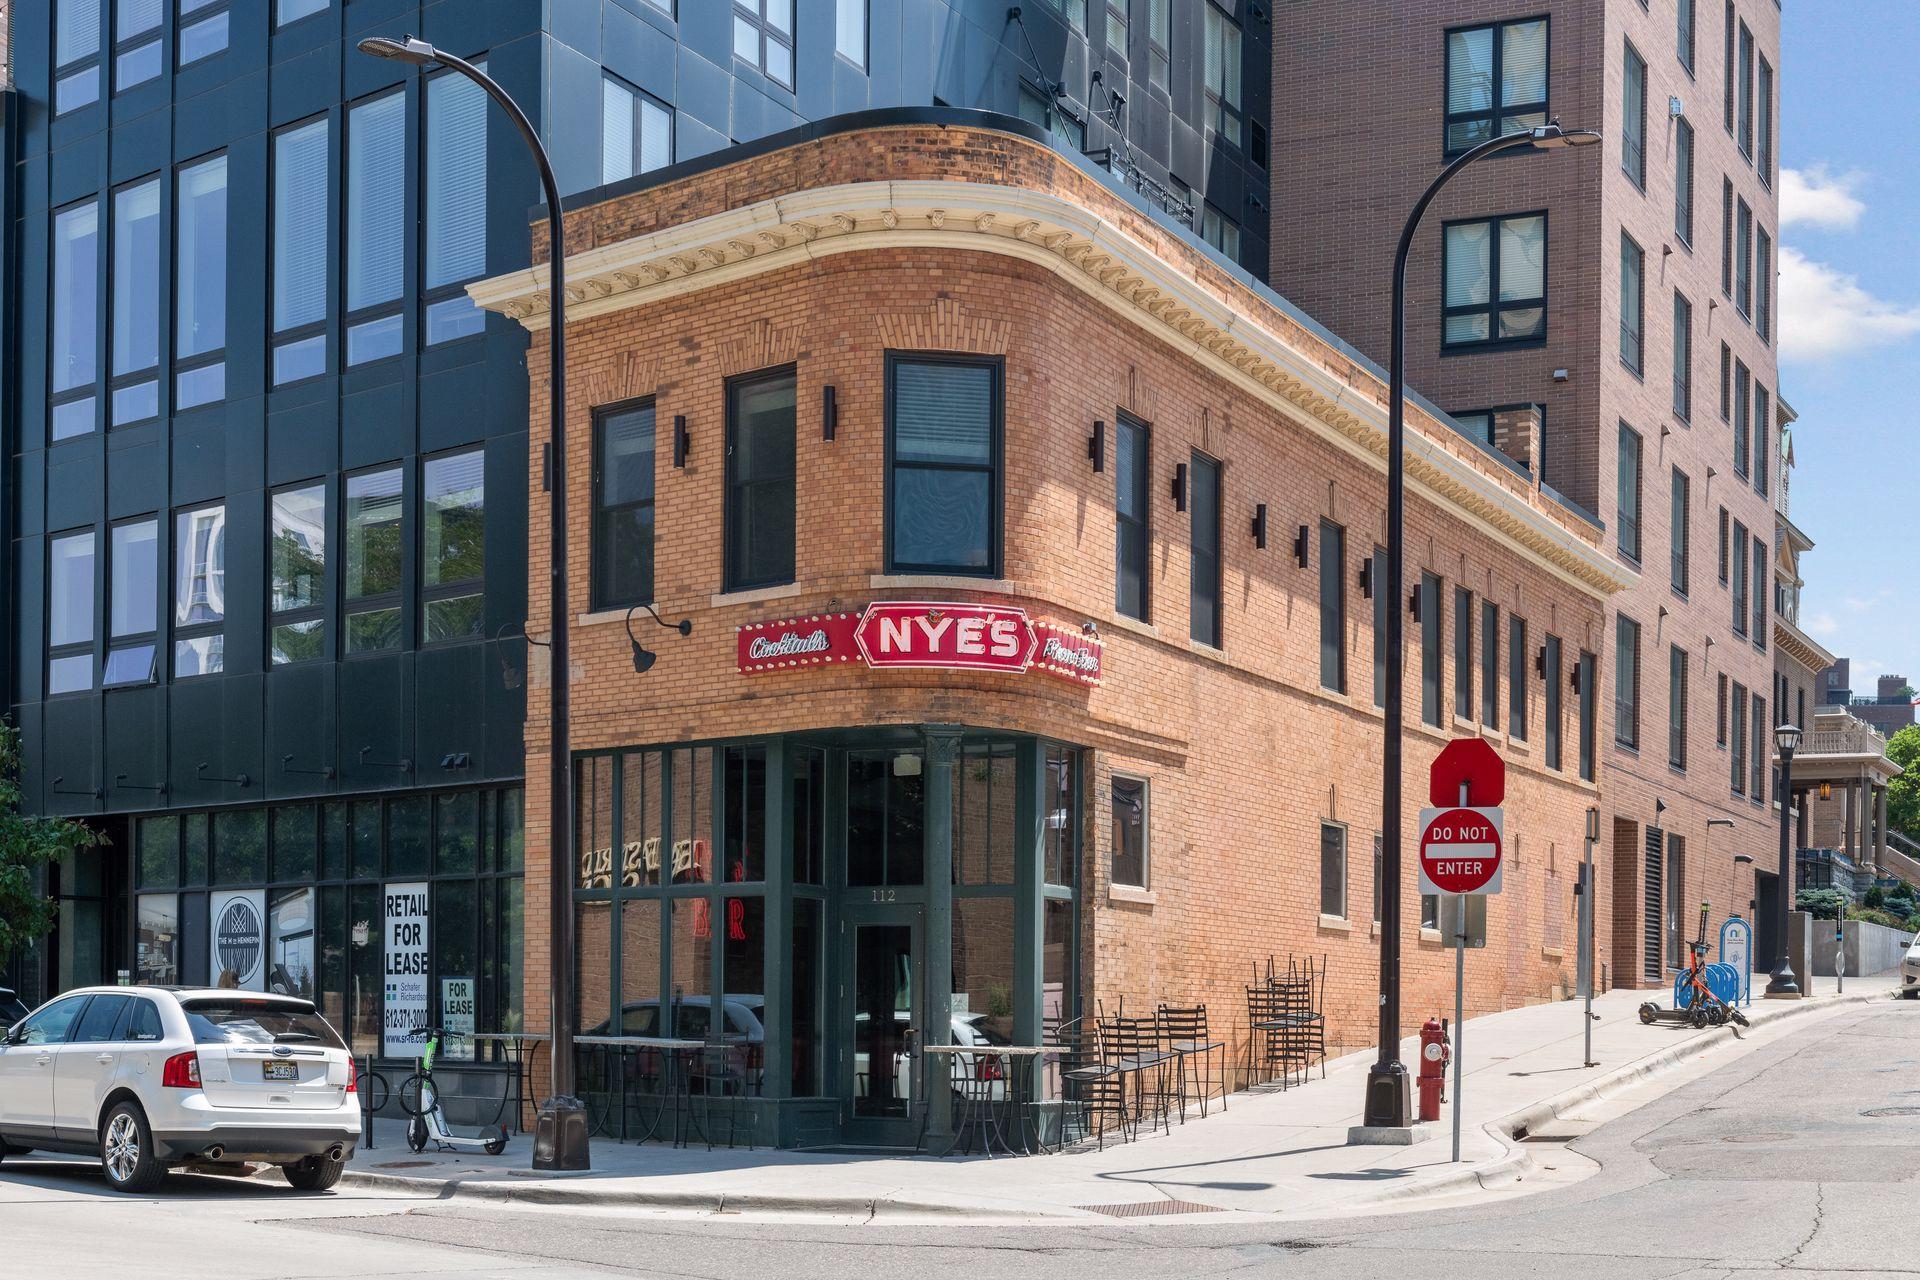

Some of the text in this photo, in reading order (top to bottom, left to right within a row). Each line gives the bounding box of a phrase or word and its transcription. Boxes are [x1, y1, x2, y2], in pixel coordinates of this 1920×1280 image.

[879, 613, 1020, 658] NYE'S
[750, 629, 830, 659] Cocktails
[1433, 826, 1489, 840] DO NOT
[1437, 861, 1483, 875] ENTER
[872, 889, 896, 902] 112
[386, 893, 428, 918] RETAIL
[218, 937, 227, 945] THE
[237, 936, 260, 944] HENNEPIN
[394, 923, 422, 946] FOR
[386, 952, 428, 975] LEASE
[449, 982, 467, 998] FOR
[444, 1000, 473, 1015] LEASE
